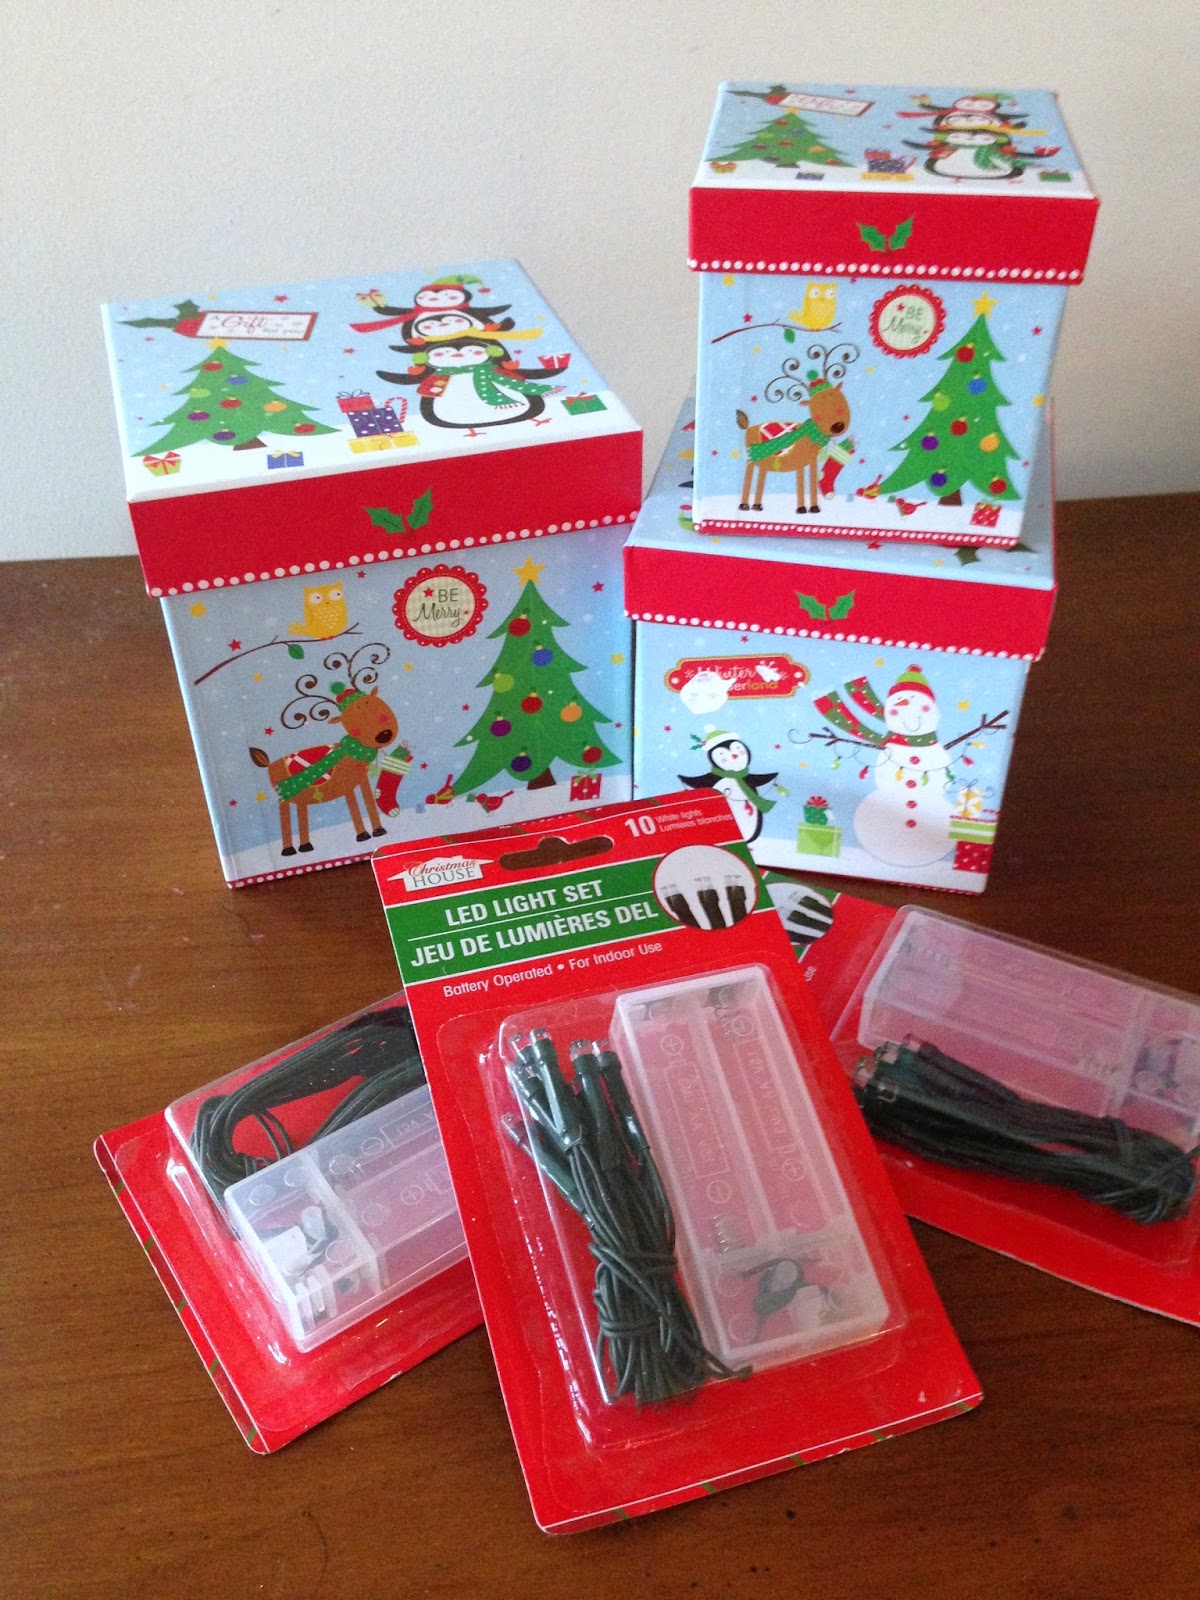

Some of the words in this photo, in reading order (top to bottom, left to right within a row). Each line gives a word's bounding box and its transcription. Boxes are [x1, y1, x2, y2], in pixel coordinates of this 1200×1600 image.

[438, 588, 459, 602] BE
[412, 602, 464, 628] Merry
[624, 815, 657, 838] 10
[403, 859, 477, 877] Christmas
[411, 866, 476, 888] HOUSE
[445, 903, 488, 927] LED
[492, 888, 557, 917] LIGHT
[562, 879, 603, 902] SET
[410, 940, 455, 968] JEU
[460, 934, 492, 957] DE
[498, 911, 612, 949] LUMIÈRES
[614, 901, 659, 925] DEL
[443, 977, 489, 998] Battery
[492, 963, 553, 988] Operated
[568, 956, 590, 971] For
[593, 948, 636, 965] Indoor
[640, 941, 663, 956] Use
